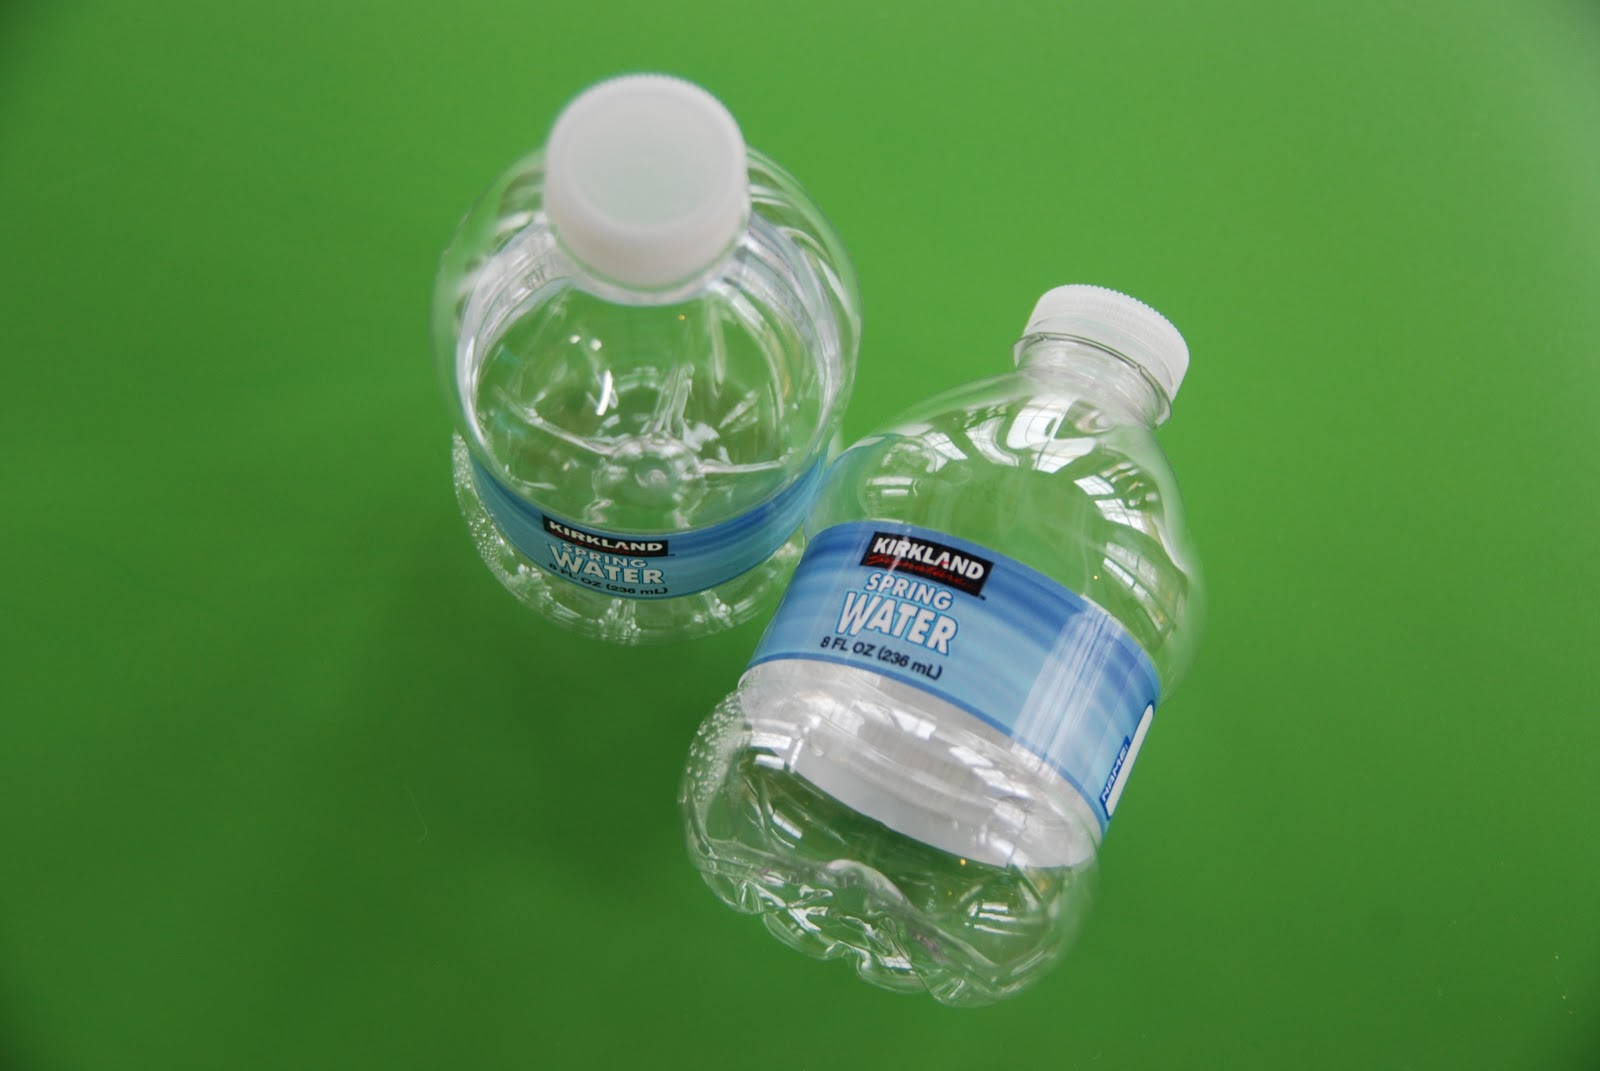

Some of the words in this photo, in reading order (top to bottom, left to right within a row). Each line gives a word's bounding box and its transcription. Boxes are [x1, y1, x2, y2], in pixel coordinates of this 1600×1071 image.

[549, 520, 663, 552] KIRKLAND
[561, 542, 648, 569] SPRING
[549, 544, 665, 585] WATER
[873, 537, 985, 580] KIRKLAND
[560, 568, 577, 580] FL
[581, 577, 602, 588] OZ
[606, 583, 636, 594] (236
[640, 586, 668, 595] mL)
[865, 572, 953, 610] SPRING
[836, 591, 957, 656] WATER
[820, 636, 831, 648] 8
[832, 637, 848, 651] FL
[852, 641, 877, 657] OZ
[877, 645, 911, 667] (236
[911, 661, 943, 680] mL)
